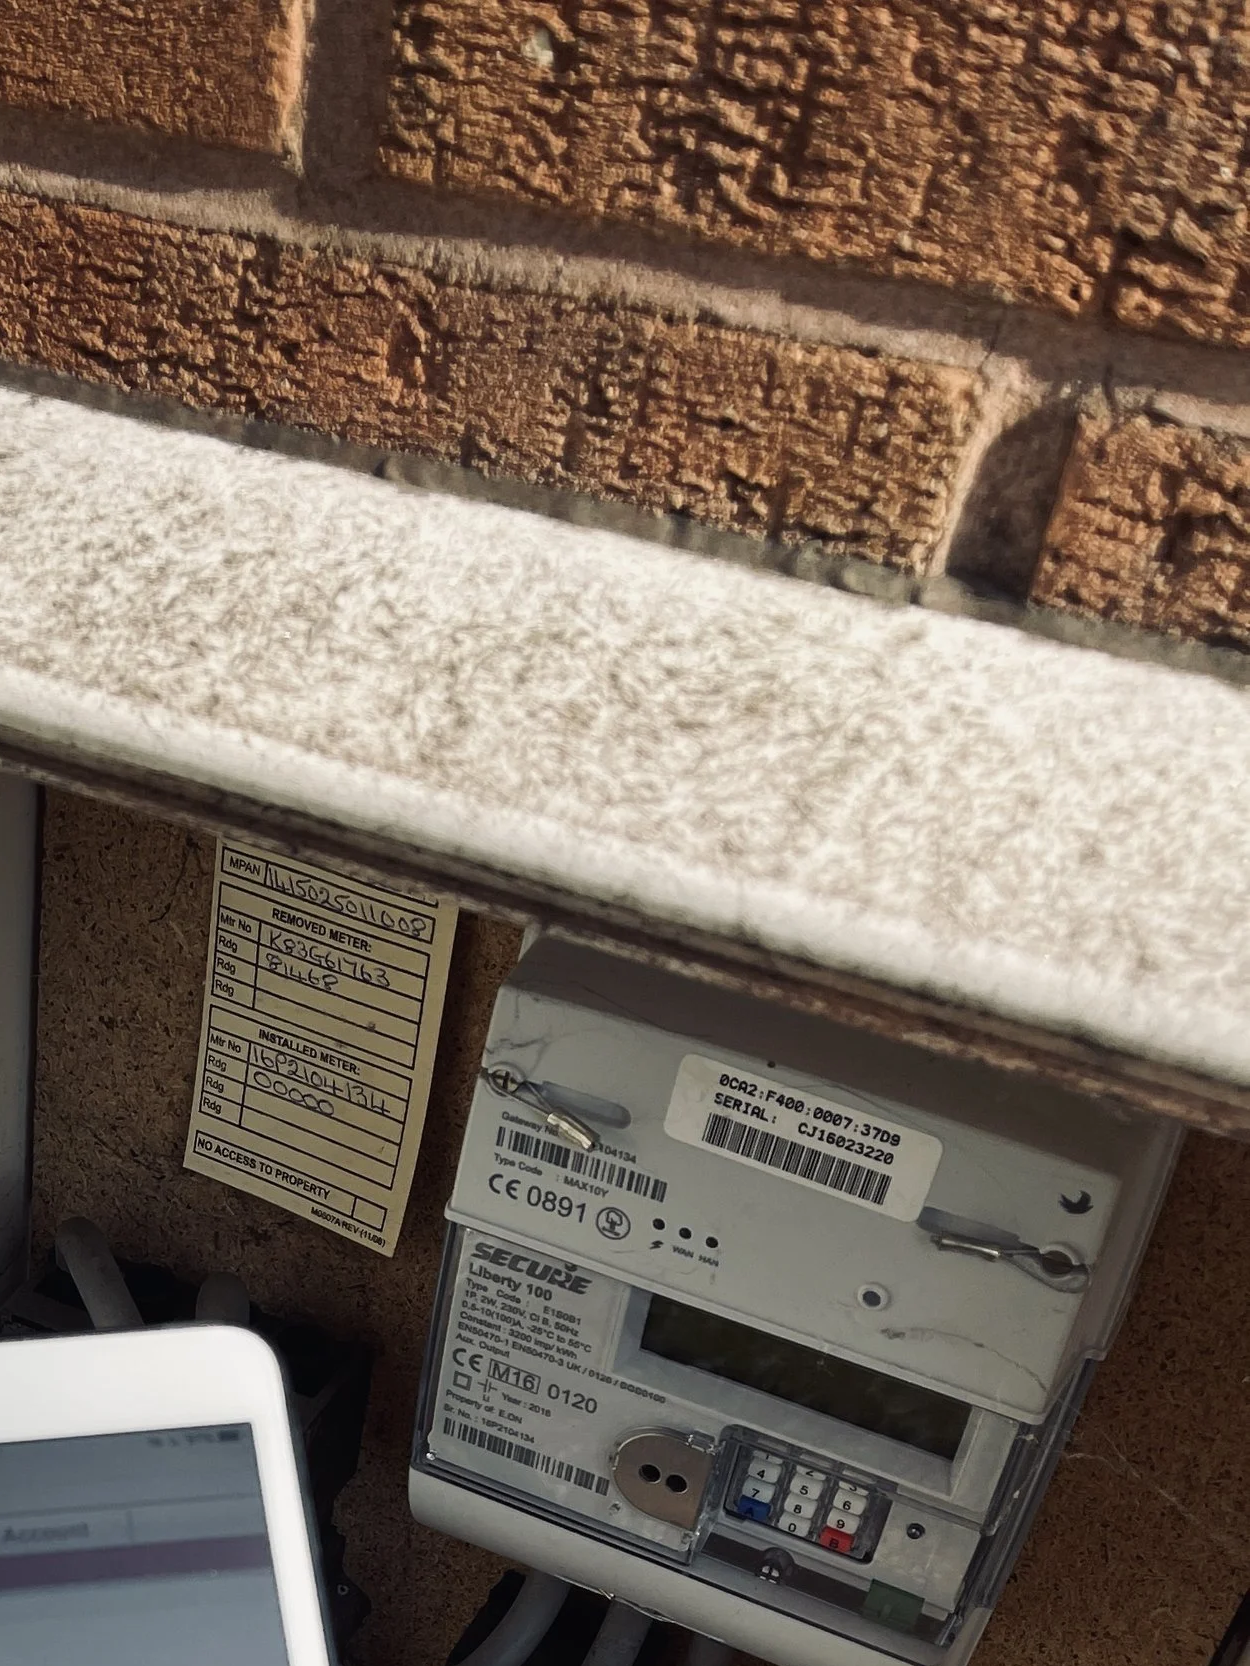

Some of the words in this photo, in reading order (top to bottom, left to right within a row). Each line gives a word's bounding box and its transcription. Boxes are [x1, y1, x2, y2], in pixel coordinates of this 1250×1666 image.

[229, 856, 261, 876] MPAN
[220, 912, 237, 927] Mtr
[238, 919, 252, 933] No
[271, 907, 327, 936] REMOVED
[329, 929, 372, 953] METER:
[218, 935, 238, 953] Rdg
[217, 957, 236, 975] Rdg
[215, 979, 235, 997] Rdg
[210, 1033, 226, 1047] Mtr
[227, 1041, 241, 1053] No
[258, 1028, 317, 1058] INSTALLED
[320, 1051, 361, 1076] METER:
[208, 1055, 227, 1072] Rdg
[205, 1076, 225, 1093] Rdg
[203, 1096, 222, 1114] Rdg
[501, 1111, 543, 1133] Gateway
[714, 1092, 777, 1124] SERIAL:
[797, 1122, 895, 1165] CJ16023220
[197, 1137, 213, 1152] NO
[213, 1144, 257, 1169] ACCESS
[259, 1160, 273, 1176] TO
[275, 1169, 331, 1200] PROPERTY
[494, 1152, 516, 1167] Type
[518, 1161, 543, 1176] Code
[563, 1175, 610, 1198] MAX10Y
[527, 1185, 587, 1224] 0891
[470, 1242, 593, 1295] SECURE
[466, 1277, 488, 1292] Type
[496, 1289, 521, 1304] Code
[468, 1262, 522, 1292] Liberty
[526, 1283, 553, 1301] 100
[459, 1311, 502, 1332] Constant
[508, 1328, 532, 1343] 3200
[554, 1321, 579, 1337] 50Hz
[457, 1321, 509, 1346] EN50470-1
[566, 1361, 582, 1373] UK
[556, 1332, 566, 1344] to
[478, 1340, 510, 1358] Output
[492, 1362, 536, 1391] M16
[547, 1383, 598, 1414] 0120
[446, 1389, 483, 1411] Property
[498, 1409, 523, 1424] E.ON
[501, 1392, 522, 1407] Year
[756, 1469, 766, 1479] 4
[751, 1487, 760, 1498] 7
[799, 1485, 809, 1495] 5
[793, 1504, 802, 1514] 8
[842, 1500, 852, 1511] 6
[836, 1519, 845, 1529] 9
